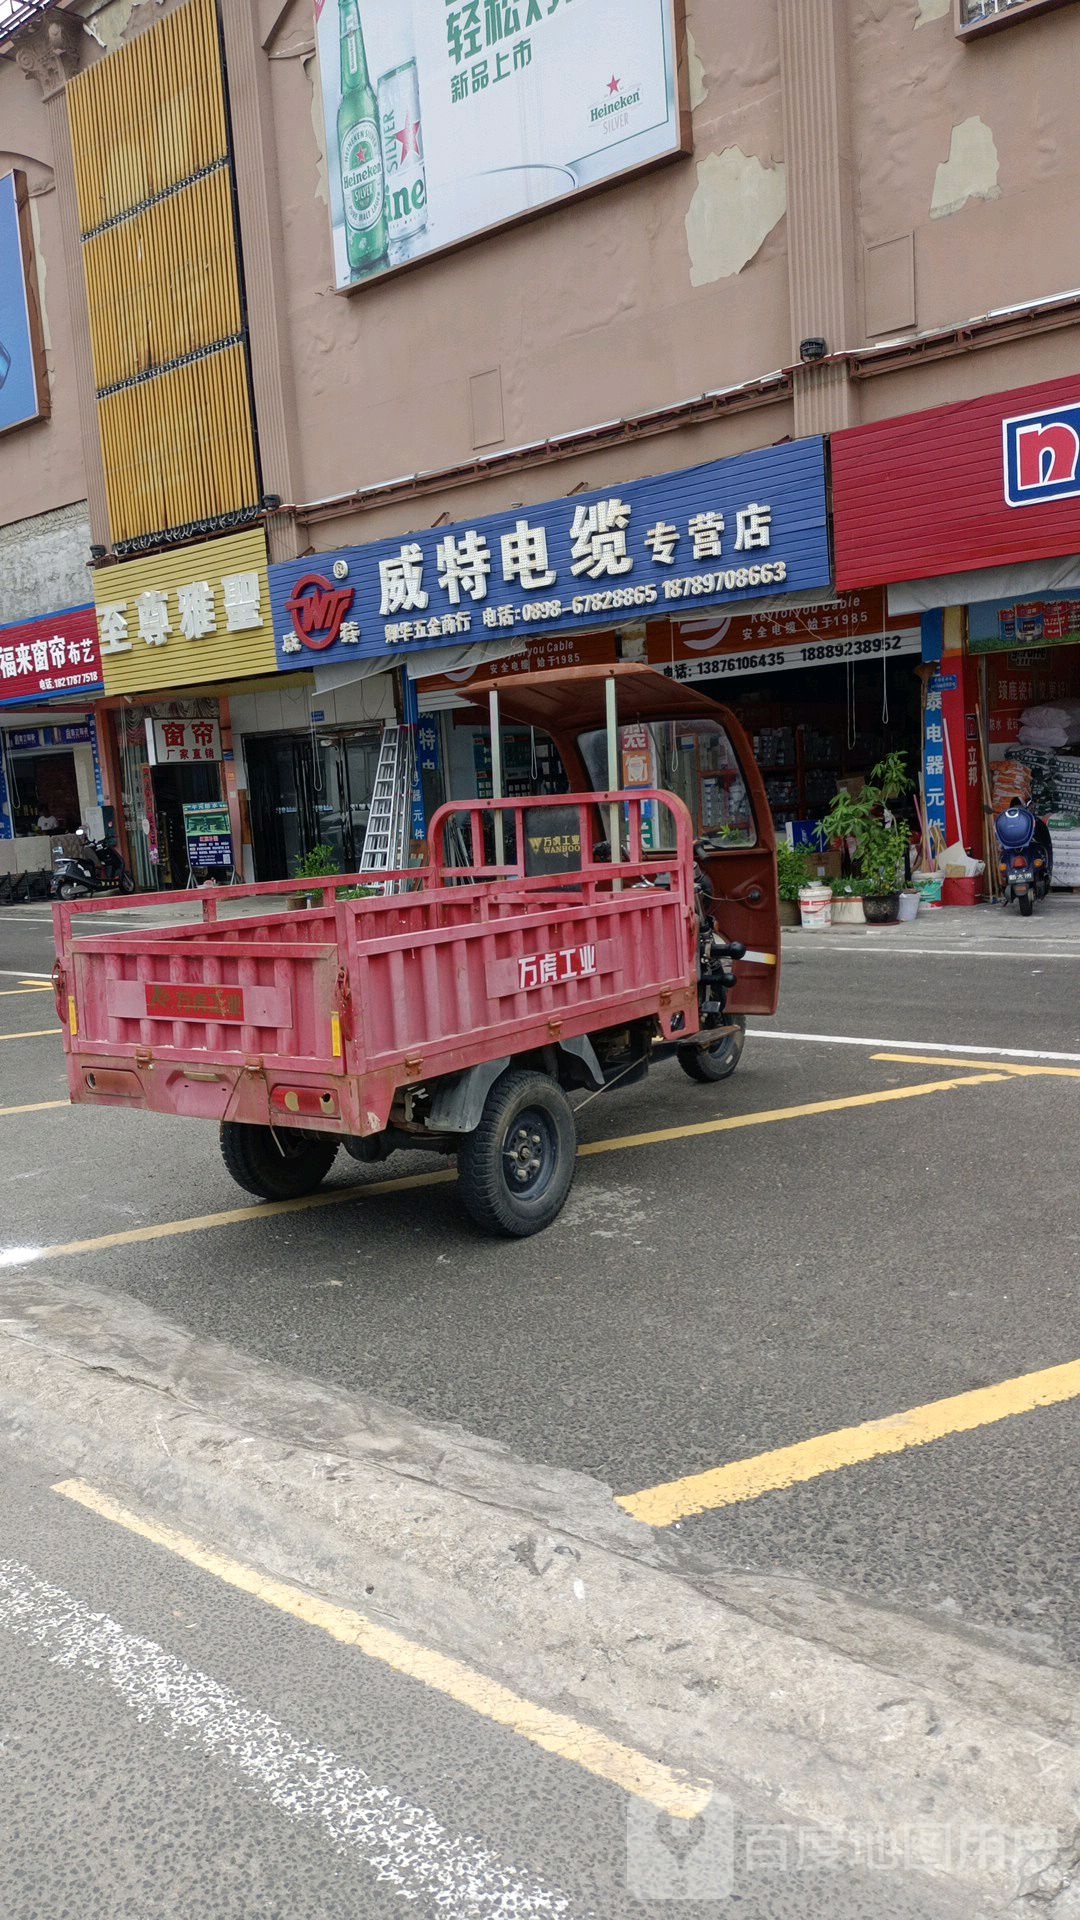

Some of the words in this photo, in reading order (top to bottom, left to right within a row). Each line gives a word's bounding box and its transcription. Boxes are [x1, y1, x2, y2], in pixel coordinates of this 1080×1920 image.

[450, 38, 532, 103] 新品上市
[590, 91, 641, 122] Heineken
[601, 112, 630, 135] SILVER
[382, 109, 399, 175] SILVER
[343, 162, 382, 190] Heineken
[378, 498, 773, 616] 威特电缆专营店
[661, 561, 787, 599] 18789708663
[536, 652, 581, 669] 始于1985
[547, 640, 574, 653] Cable
[697, 651, 786, 676] 13876106435
[800, 635, 903, 662] 18889238952
[161, 722, 214, 747] 窗帘
[166, 749, 215, 760] 厂家直销
[968, 746, 979, 786] 立邦
[518, 945, 596, 988] 万虎工业
